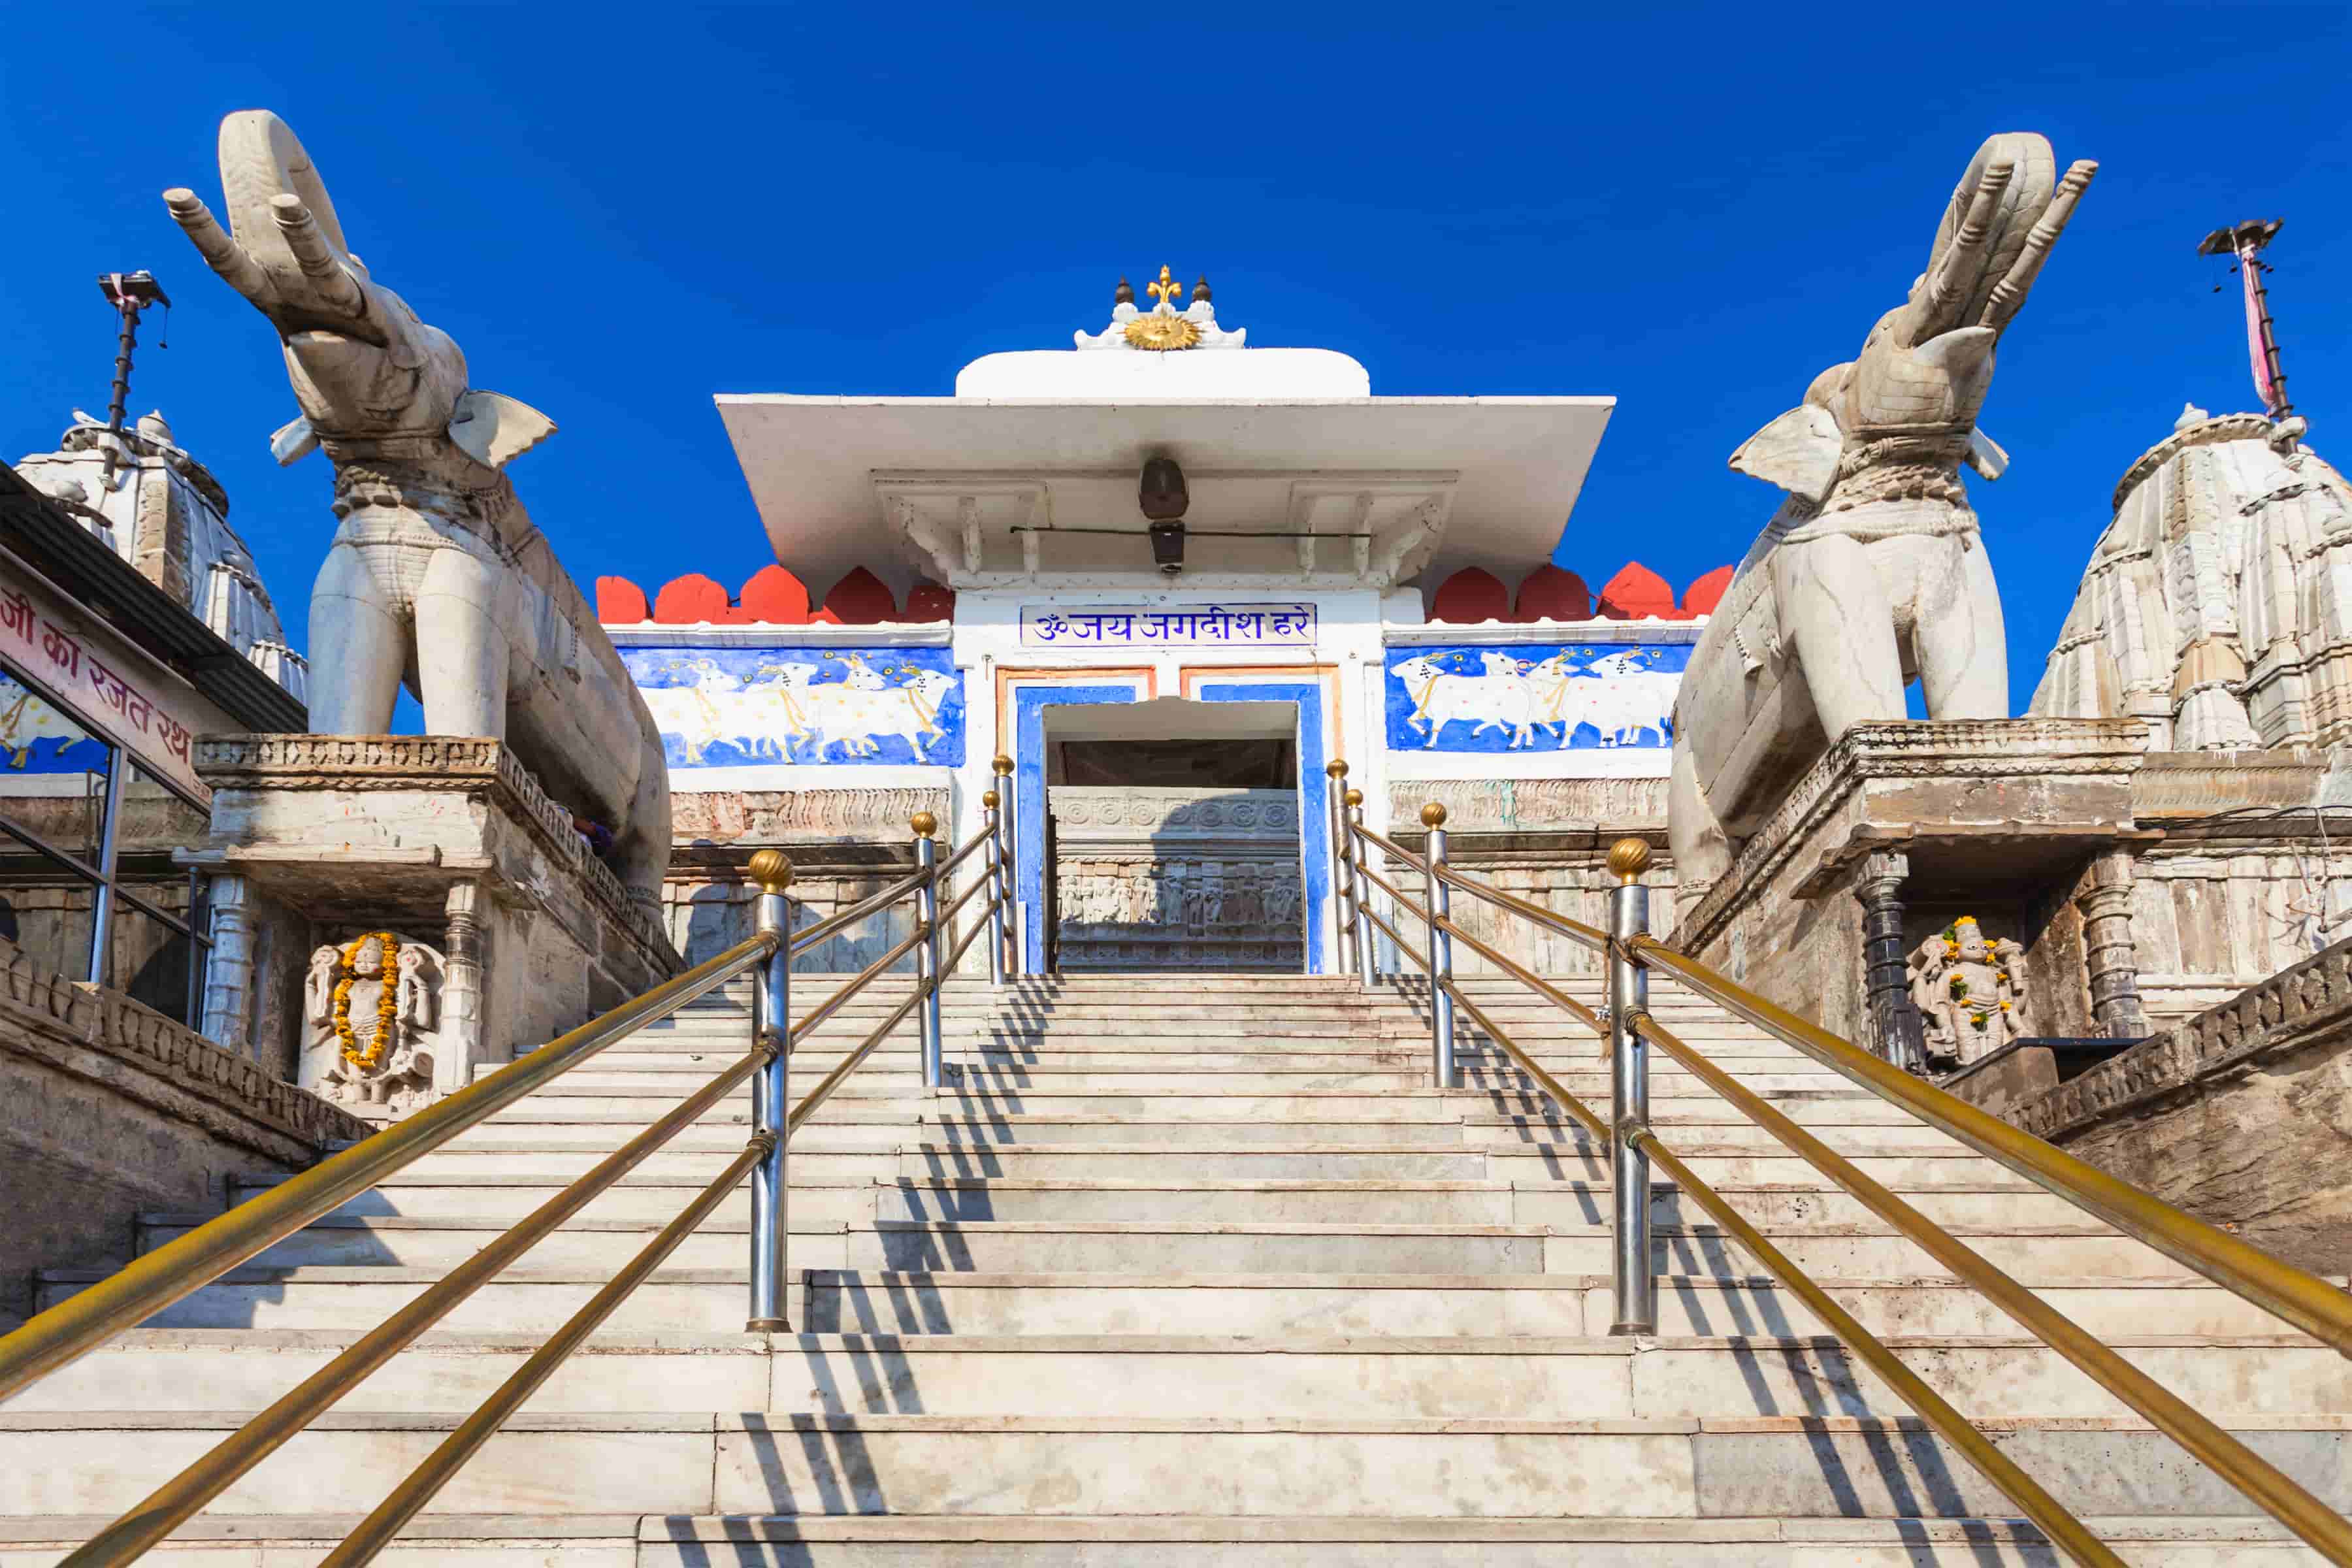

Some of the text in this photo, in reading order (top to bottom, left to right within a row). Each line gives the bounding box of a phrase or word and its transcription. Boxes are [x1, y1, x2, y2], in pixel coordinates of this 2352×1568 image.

[1068, 614, 1137, 641] जय
[1139, 606, 1265, 640] जगदीश
[1269, 606, 1310, 638] हरे
[42, 619, 81, 679] का
[89, 655, 154, 733] रजत
[157, 710, 191, 764] रथ
